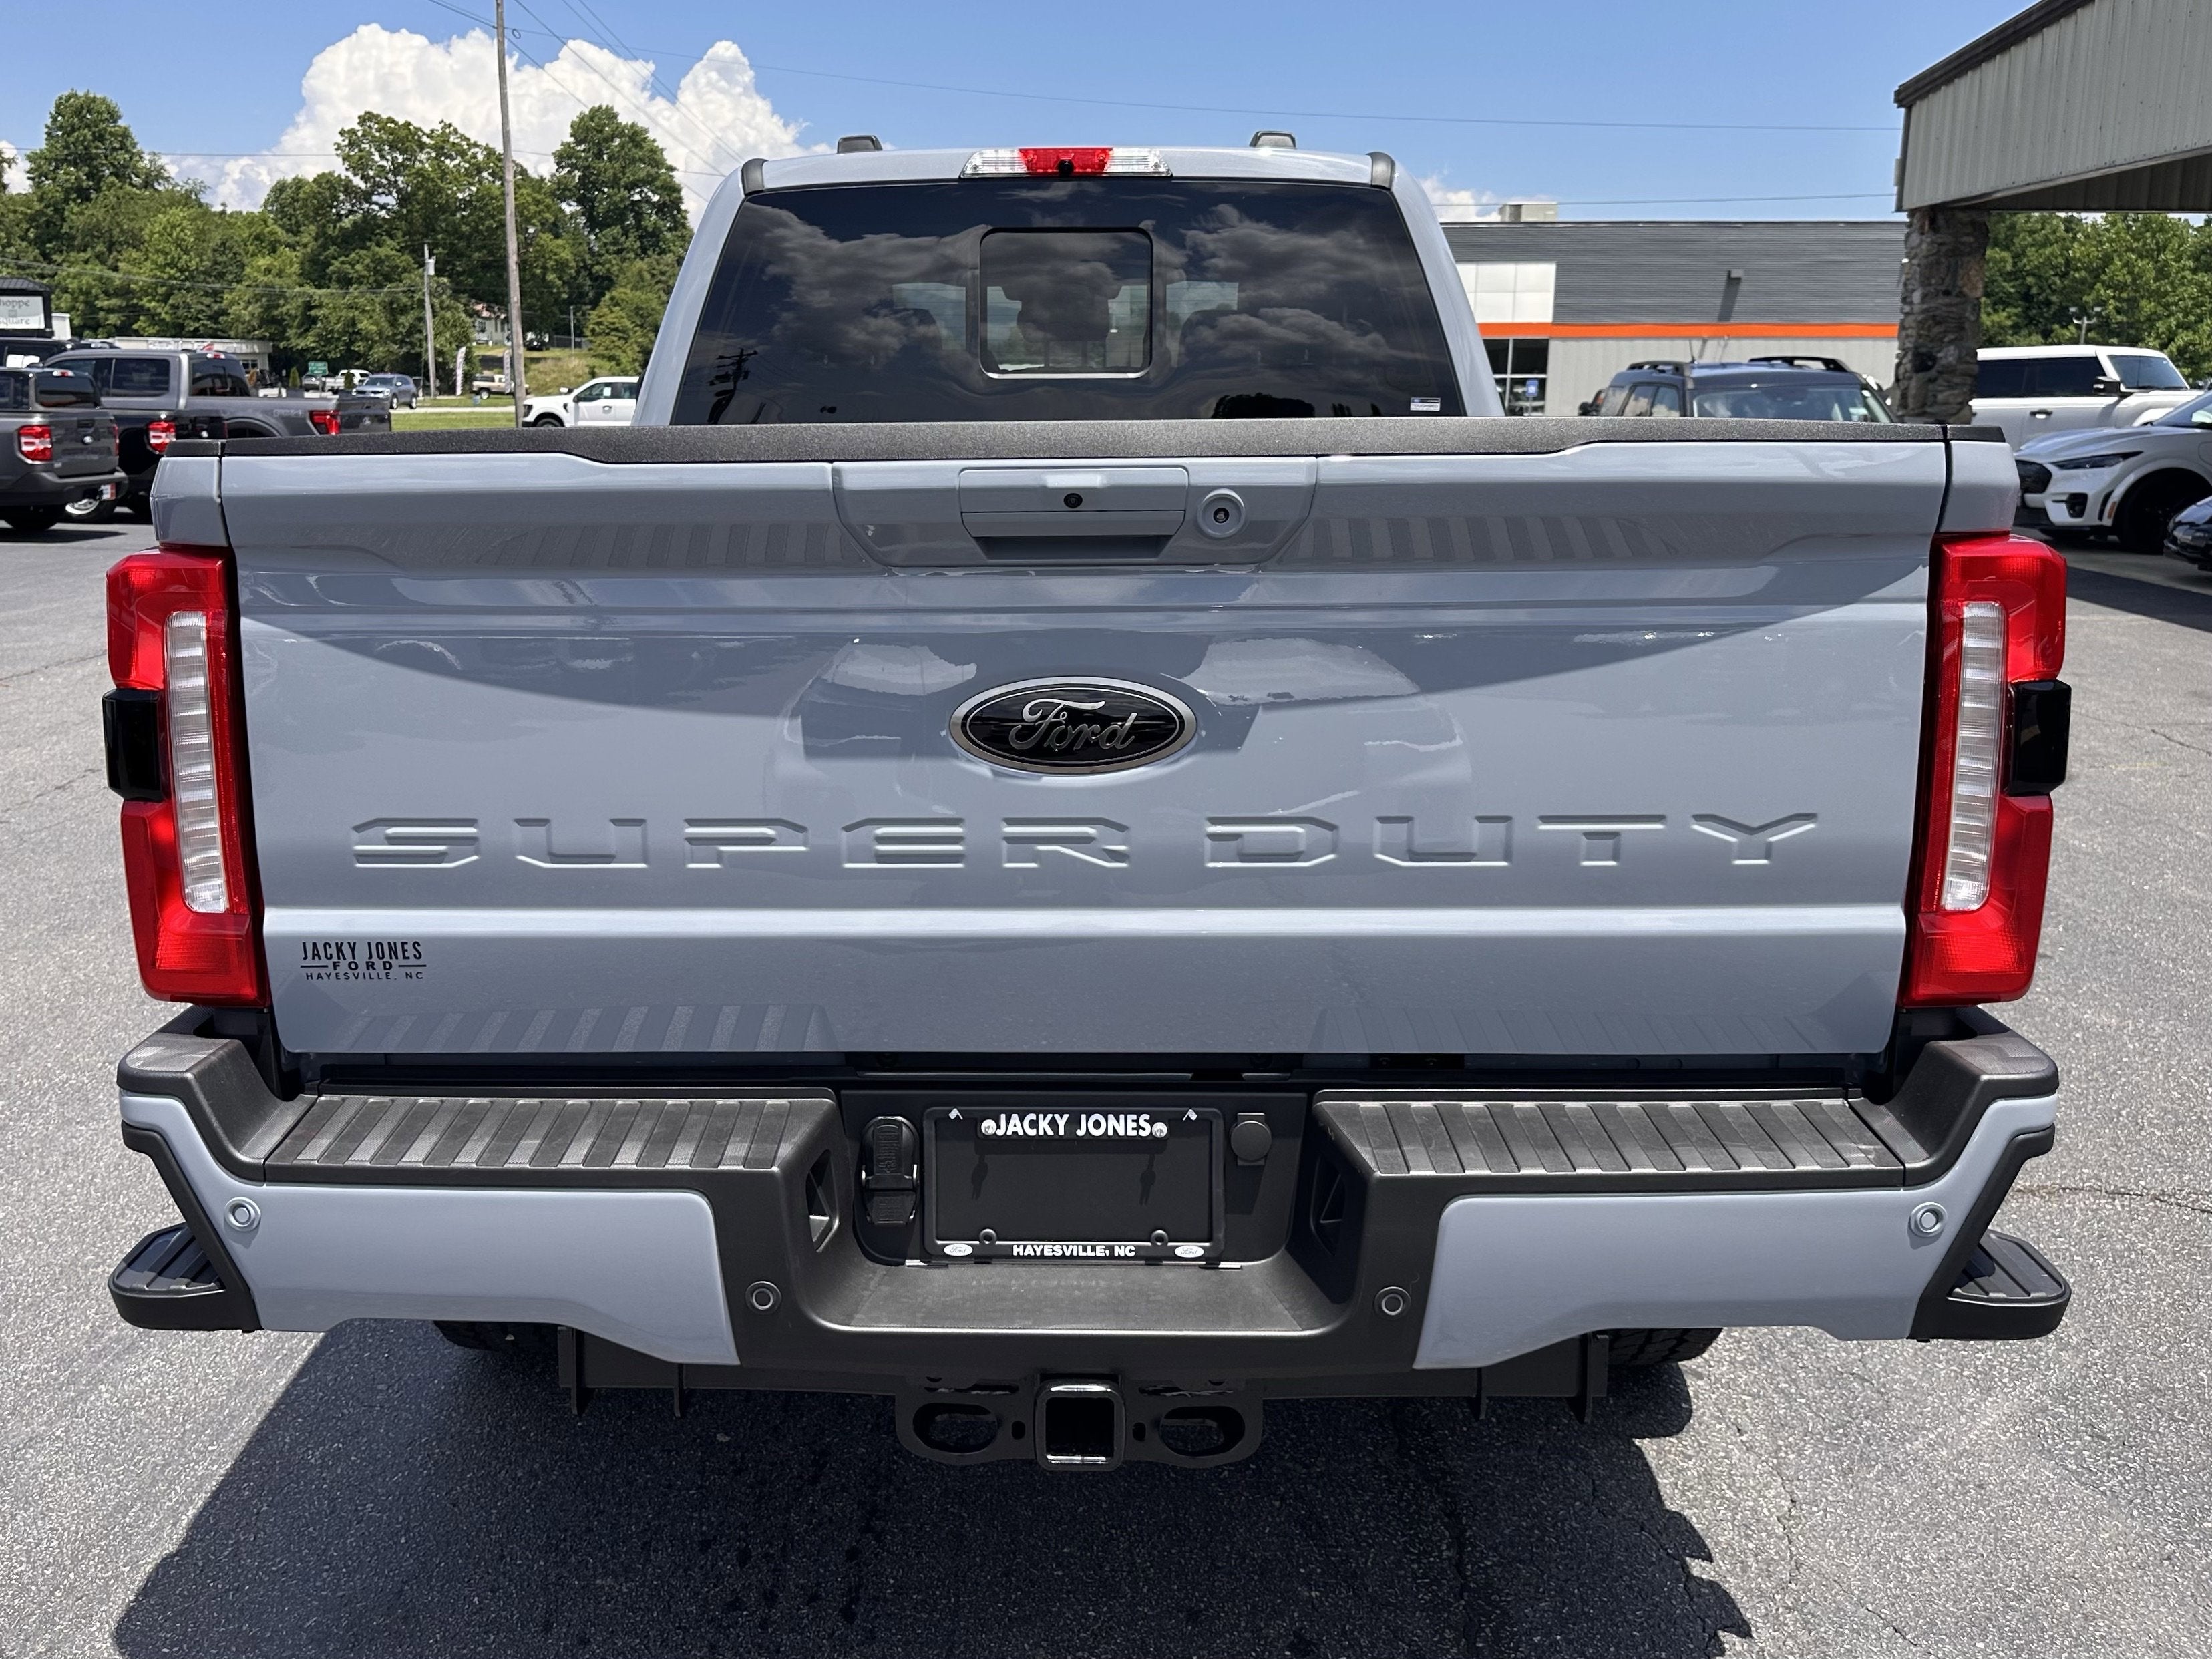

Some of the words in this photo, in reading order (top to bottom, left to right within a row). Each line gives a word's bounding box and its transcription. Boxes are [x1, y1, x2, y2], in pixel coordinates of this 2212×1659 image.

[0, 299, 30, 309] hoppe
[1008, 698, 1138, 751] Ford
[351, 817, 1131, 869] SUPER
[1204, 813, 1819, 868] DUTY
[302, 942, 357, 960] JACKY
[367, 941, 423, 960] JONES
[332, 961, 393, 971] FORD
[305, 972, 398, 980] HAYESVILLE,
[405, 971, 424, 980] NC
[996, 1113, 1069, 1137] JACKY
[1076, 1113, 1152, 1137] JONES
[1012, 1244, 1110, 1257] HAYESVILLE,
[1114, 1245, 1136, 1257] NC
